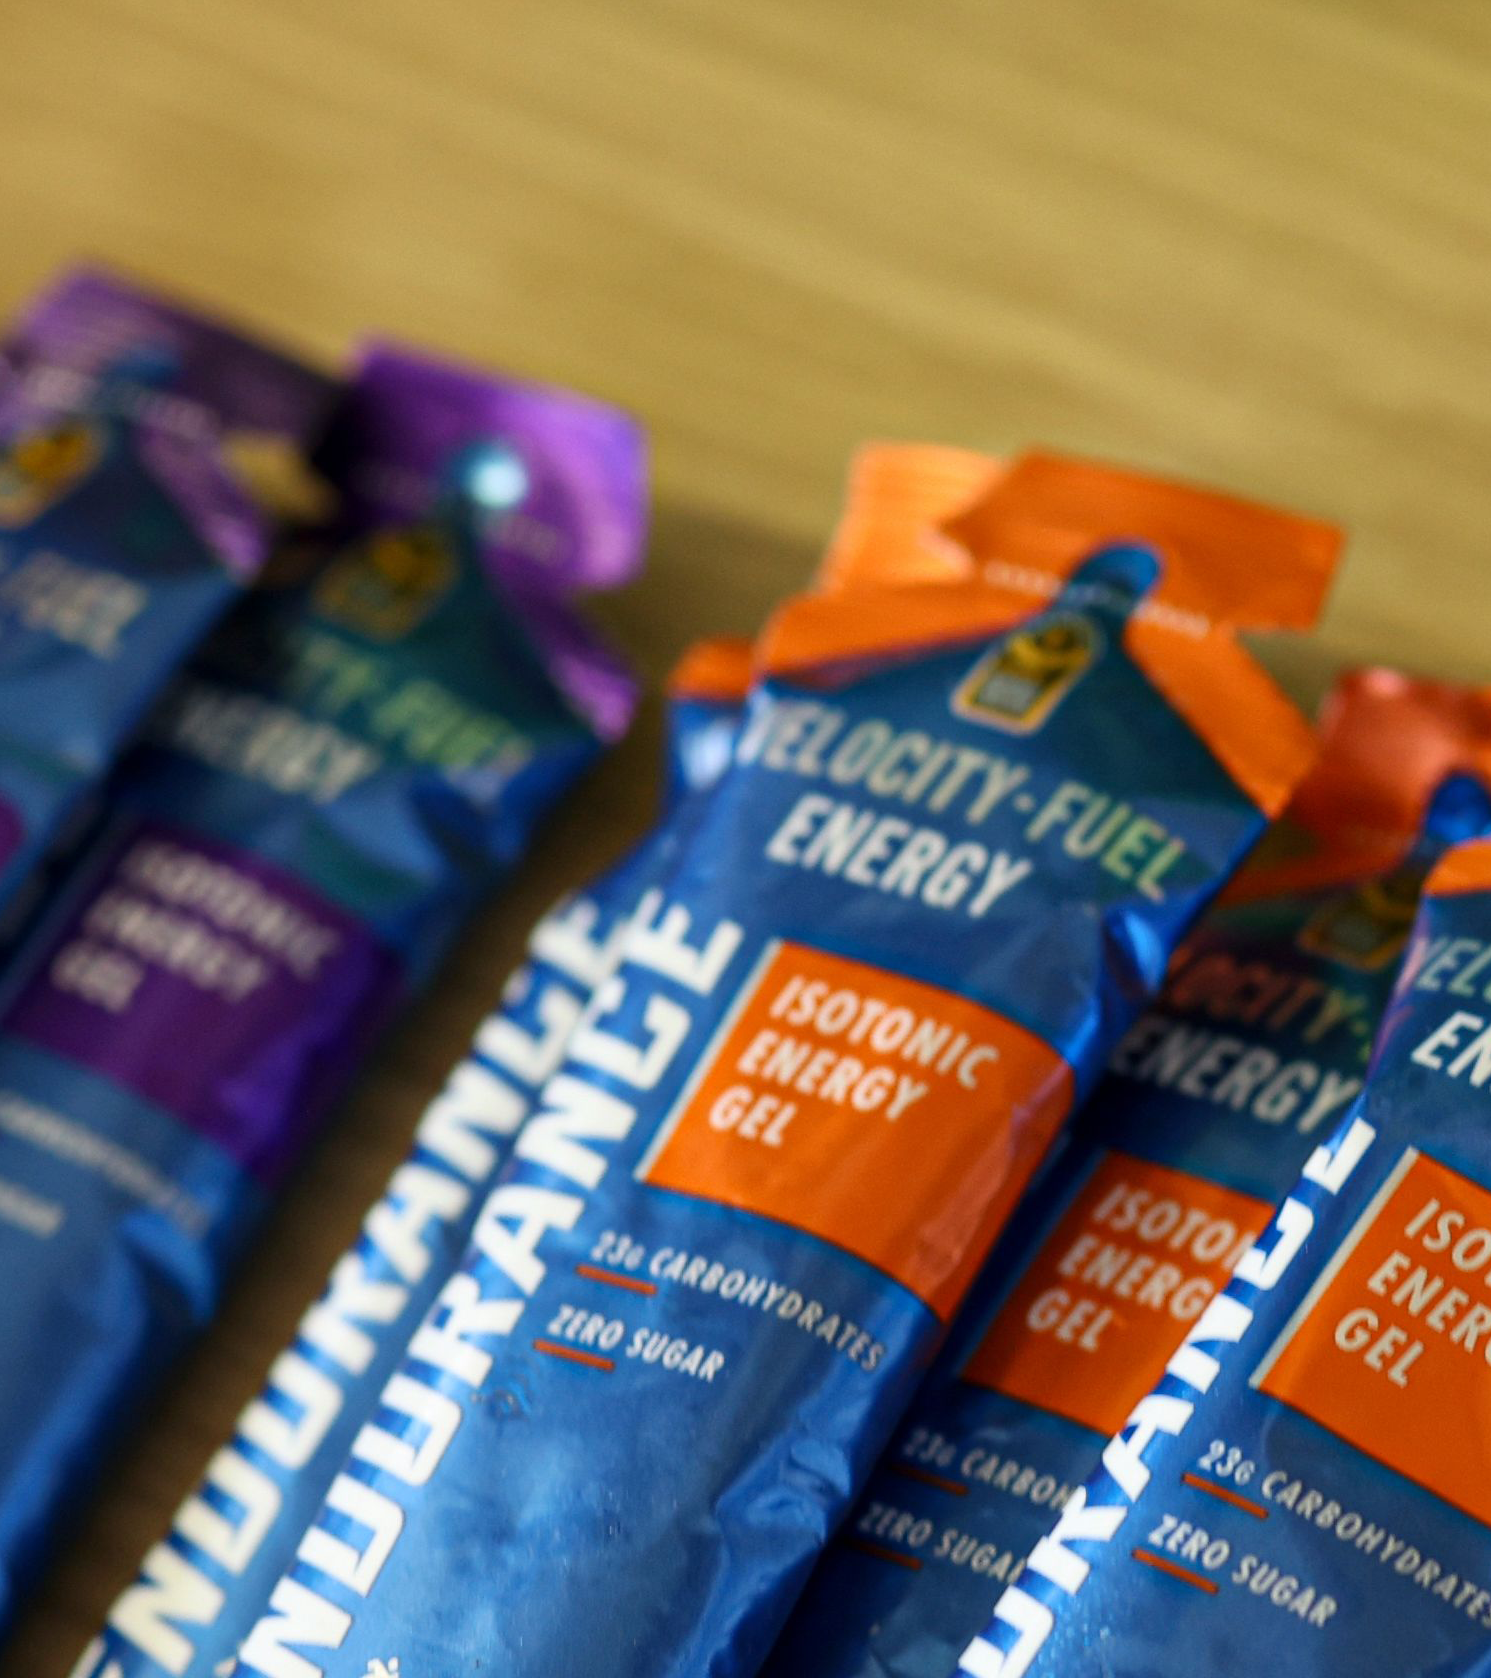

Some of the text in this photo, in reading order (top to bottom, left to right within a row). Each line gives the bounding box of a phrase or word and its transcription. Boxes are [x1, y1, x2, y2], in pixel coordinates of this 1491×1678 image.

[734, 694, 1188, 905] VELOCITY-FUEL
[766, 793, 1031, 919] ENERGY
[736, 1030, 928, 1122] ENERGY
[769, 974, 1002, 1092] ISOTONIC
[708, 1084, 802, 1149] GEL
[1093, 1180, 1255, 1274] ISOTO
[647, 1246, 887, 1374] CARBOHYDRATES
[1025, 1288, 1116, 1353] GEL
[1057, 1235, 1214, 1323] ENERG
[546, 1302, 726, 1387] ZERO SUGAR
[1333, 1307, 1427, 1390] GEL
[859, 1501, 934, 1549] ZERO
[1148, 1513, 1341, 1630] ZERO SUGAR
